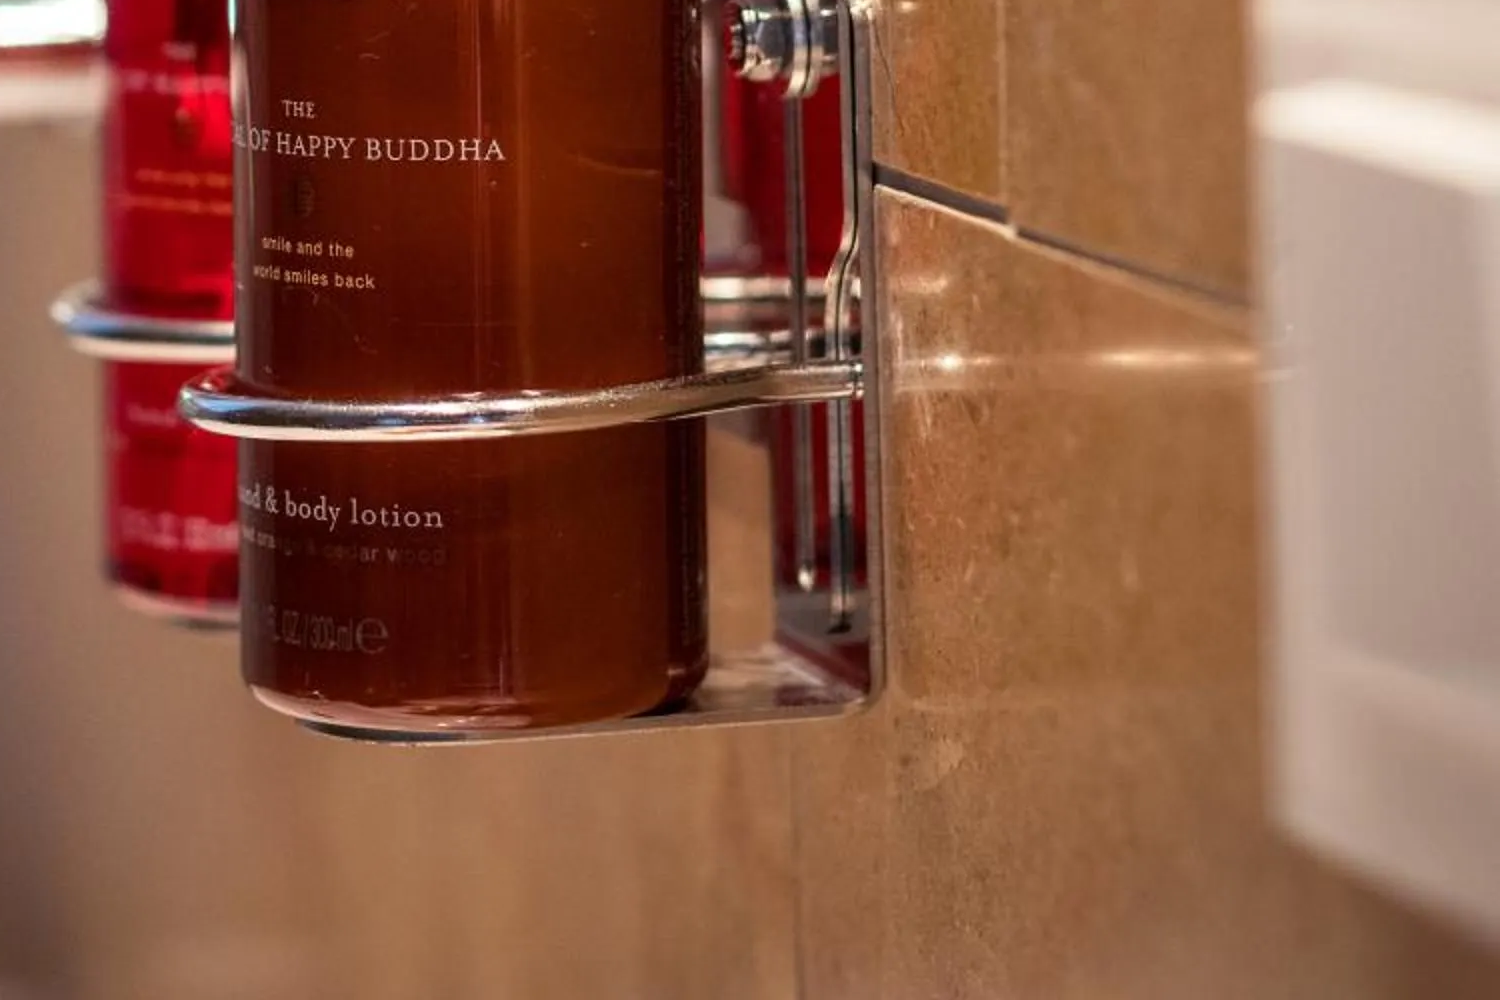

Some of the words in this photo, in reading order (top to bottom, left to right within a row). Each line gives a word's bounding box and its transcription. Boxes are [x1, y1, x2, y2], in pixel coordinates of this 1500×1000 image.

[282, 99, 316, 119] THE
[249, 128, 272, 151] OF
[276, 132, 357, 159] HAPPY
[366, 137, 506, 162] BUDDHA
[296, 239, 323, 257] and
[328, 241, 355, 260] the
[284, 267, 329, 287] smiles
[334, 271, 376, 290] back
[265, 485, 279, 514] &
[284, 489, 341, 533] body
[349, 497, 444, 528] lotion
